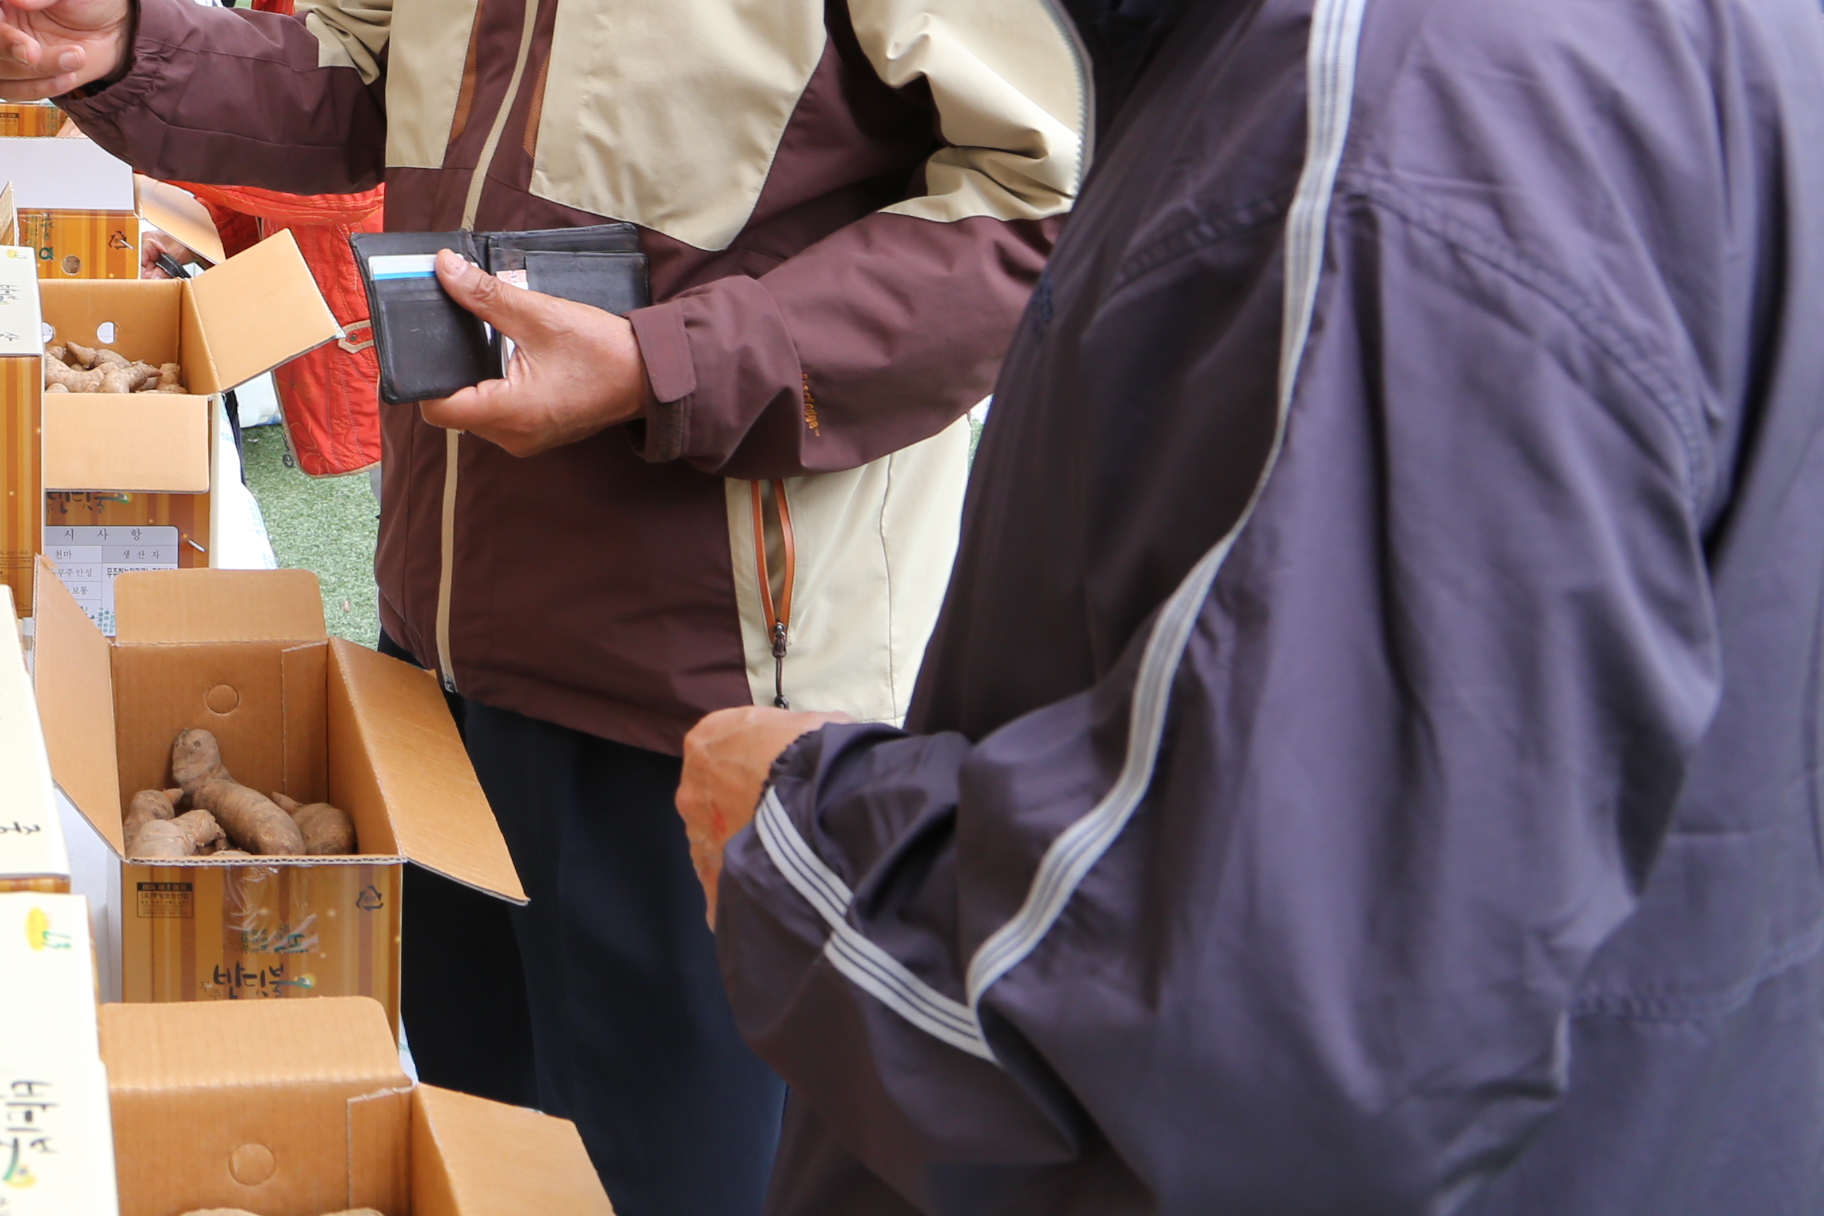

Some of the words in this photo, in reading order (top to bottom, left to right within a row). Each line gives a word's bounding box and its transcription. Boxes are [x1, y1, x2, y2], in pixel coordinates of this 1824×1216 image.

[55, 550, 72, 560] 천마
[57, 568, 74, 578] 무주
[76, 568, 93, 578] 안성
